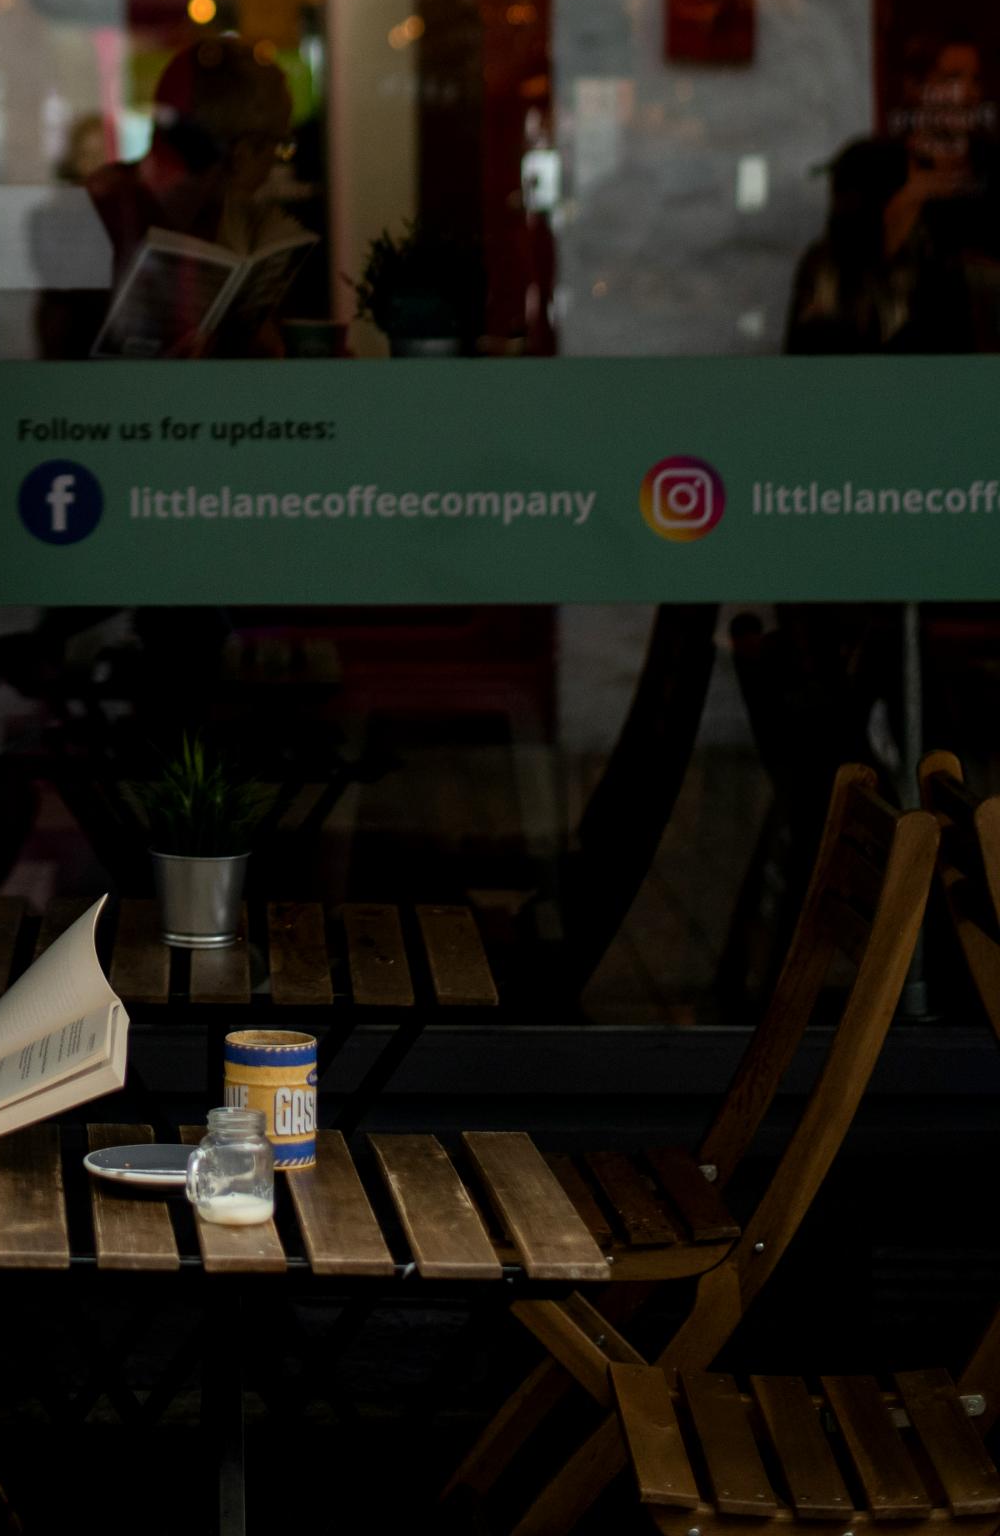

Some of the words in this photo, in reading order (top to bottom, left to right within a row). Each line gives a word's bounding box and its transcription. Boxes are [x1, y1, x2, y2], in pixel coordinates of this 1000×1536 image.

[17, 417, 111, 441] Follow
[119, 422, 151, 441] us
[160, 416, 202, 440] for
[211, 417, 336, 446] updates:
[129, 484, 597, 524] littlelanecoffeecompany
[752, 480, 1000, 514] littlelanecoff
[274, 1086, 318, 1136] GAS
